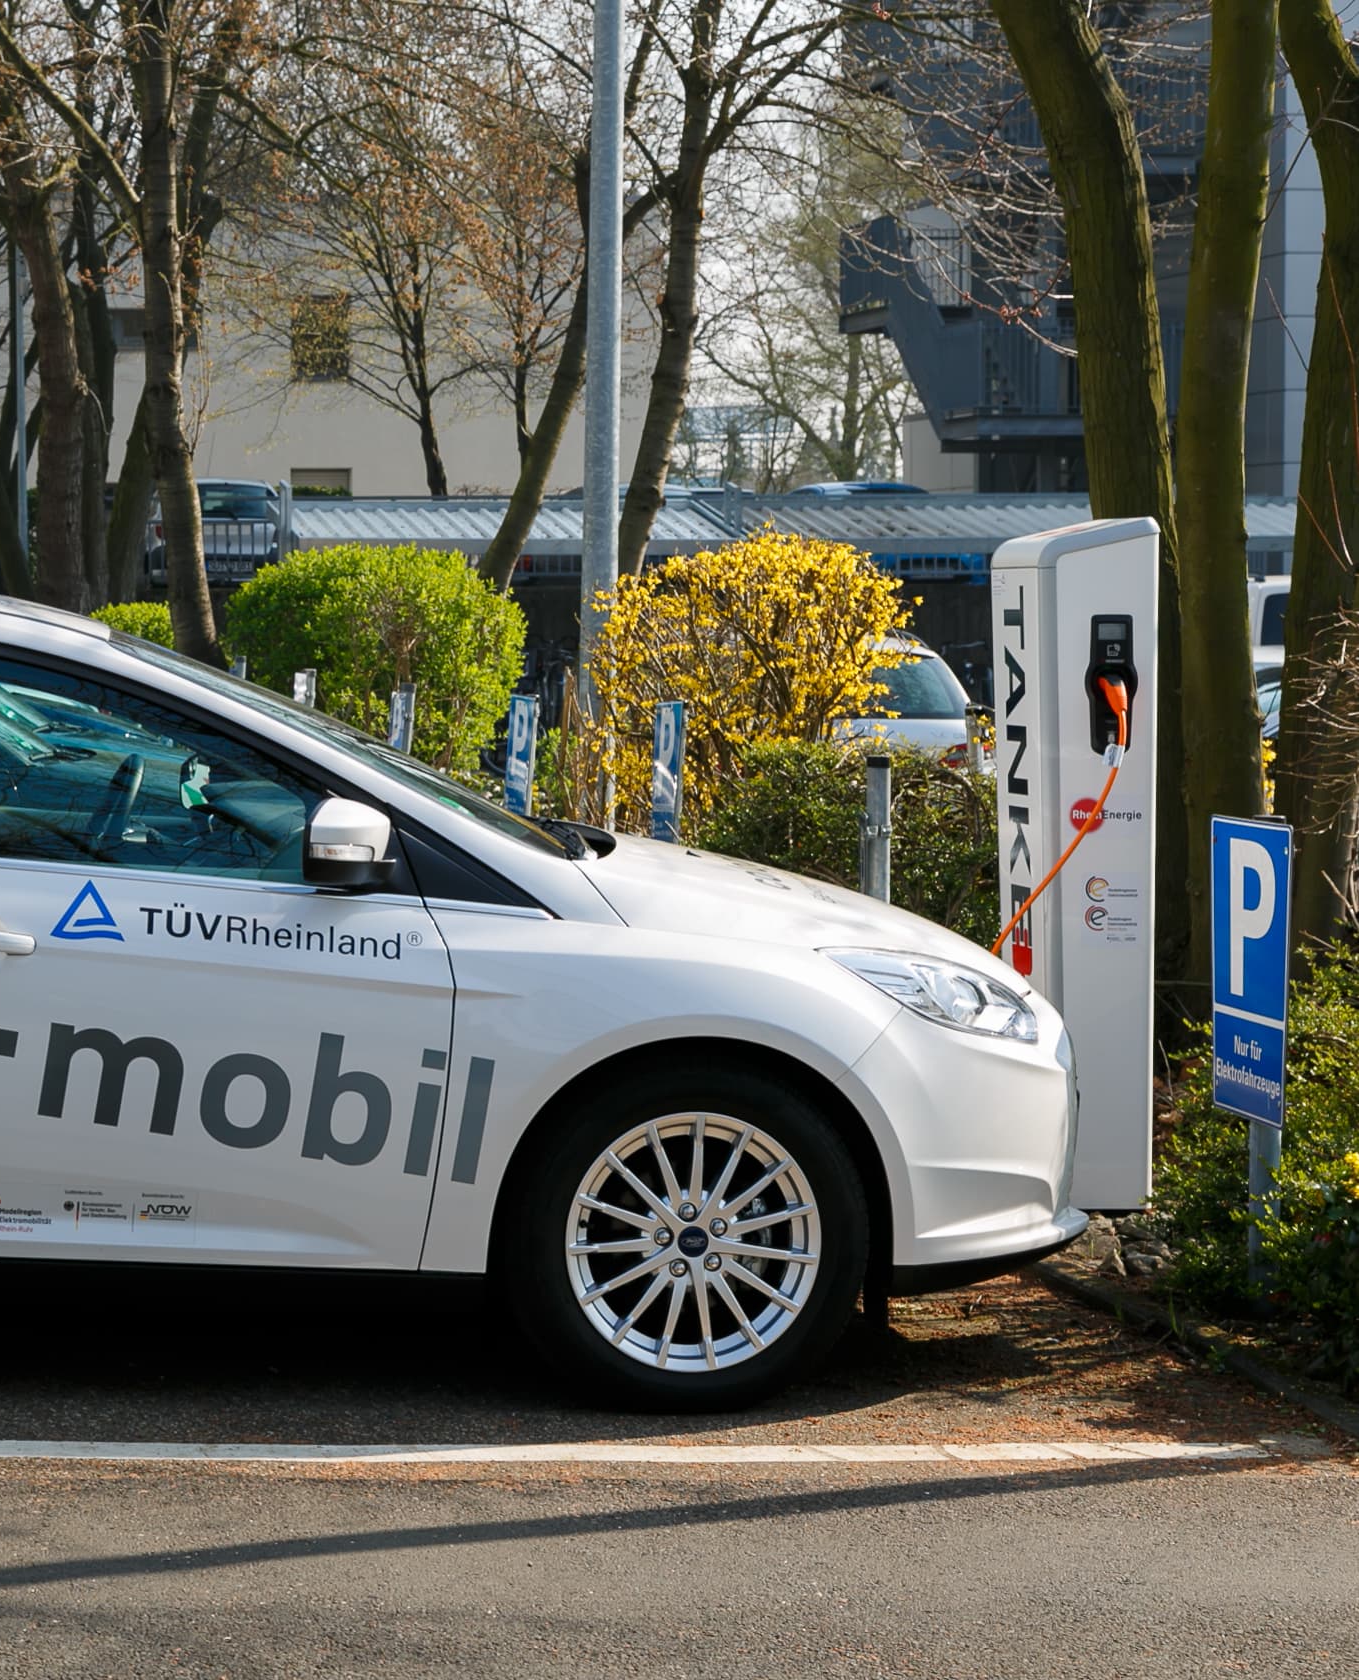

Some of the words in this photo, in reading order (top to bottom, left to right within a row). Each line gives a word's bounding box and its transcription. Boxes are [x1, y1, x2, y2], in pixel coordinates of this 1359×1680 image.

[1004, 585, 1032, 947] TANKE
[1072, 809, 1142, 822] RhenEnergie
[1230, 838, 1276, 996] P
[1234, 1034, 1249, 1057] Nur
[1250, 1039, 1262, 1062] für
[1216, 1056, 1281, 1099] Elektrofahrzeuge
[37, 1022, 496, 1185] mobil
[0, 1216, 52, 1225] Elektromobilität
